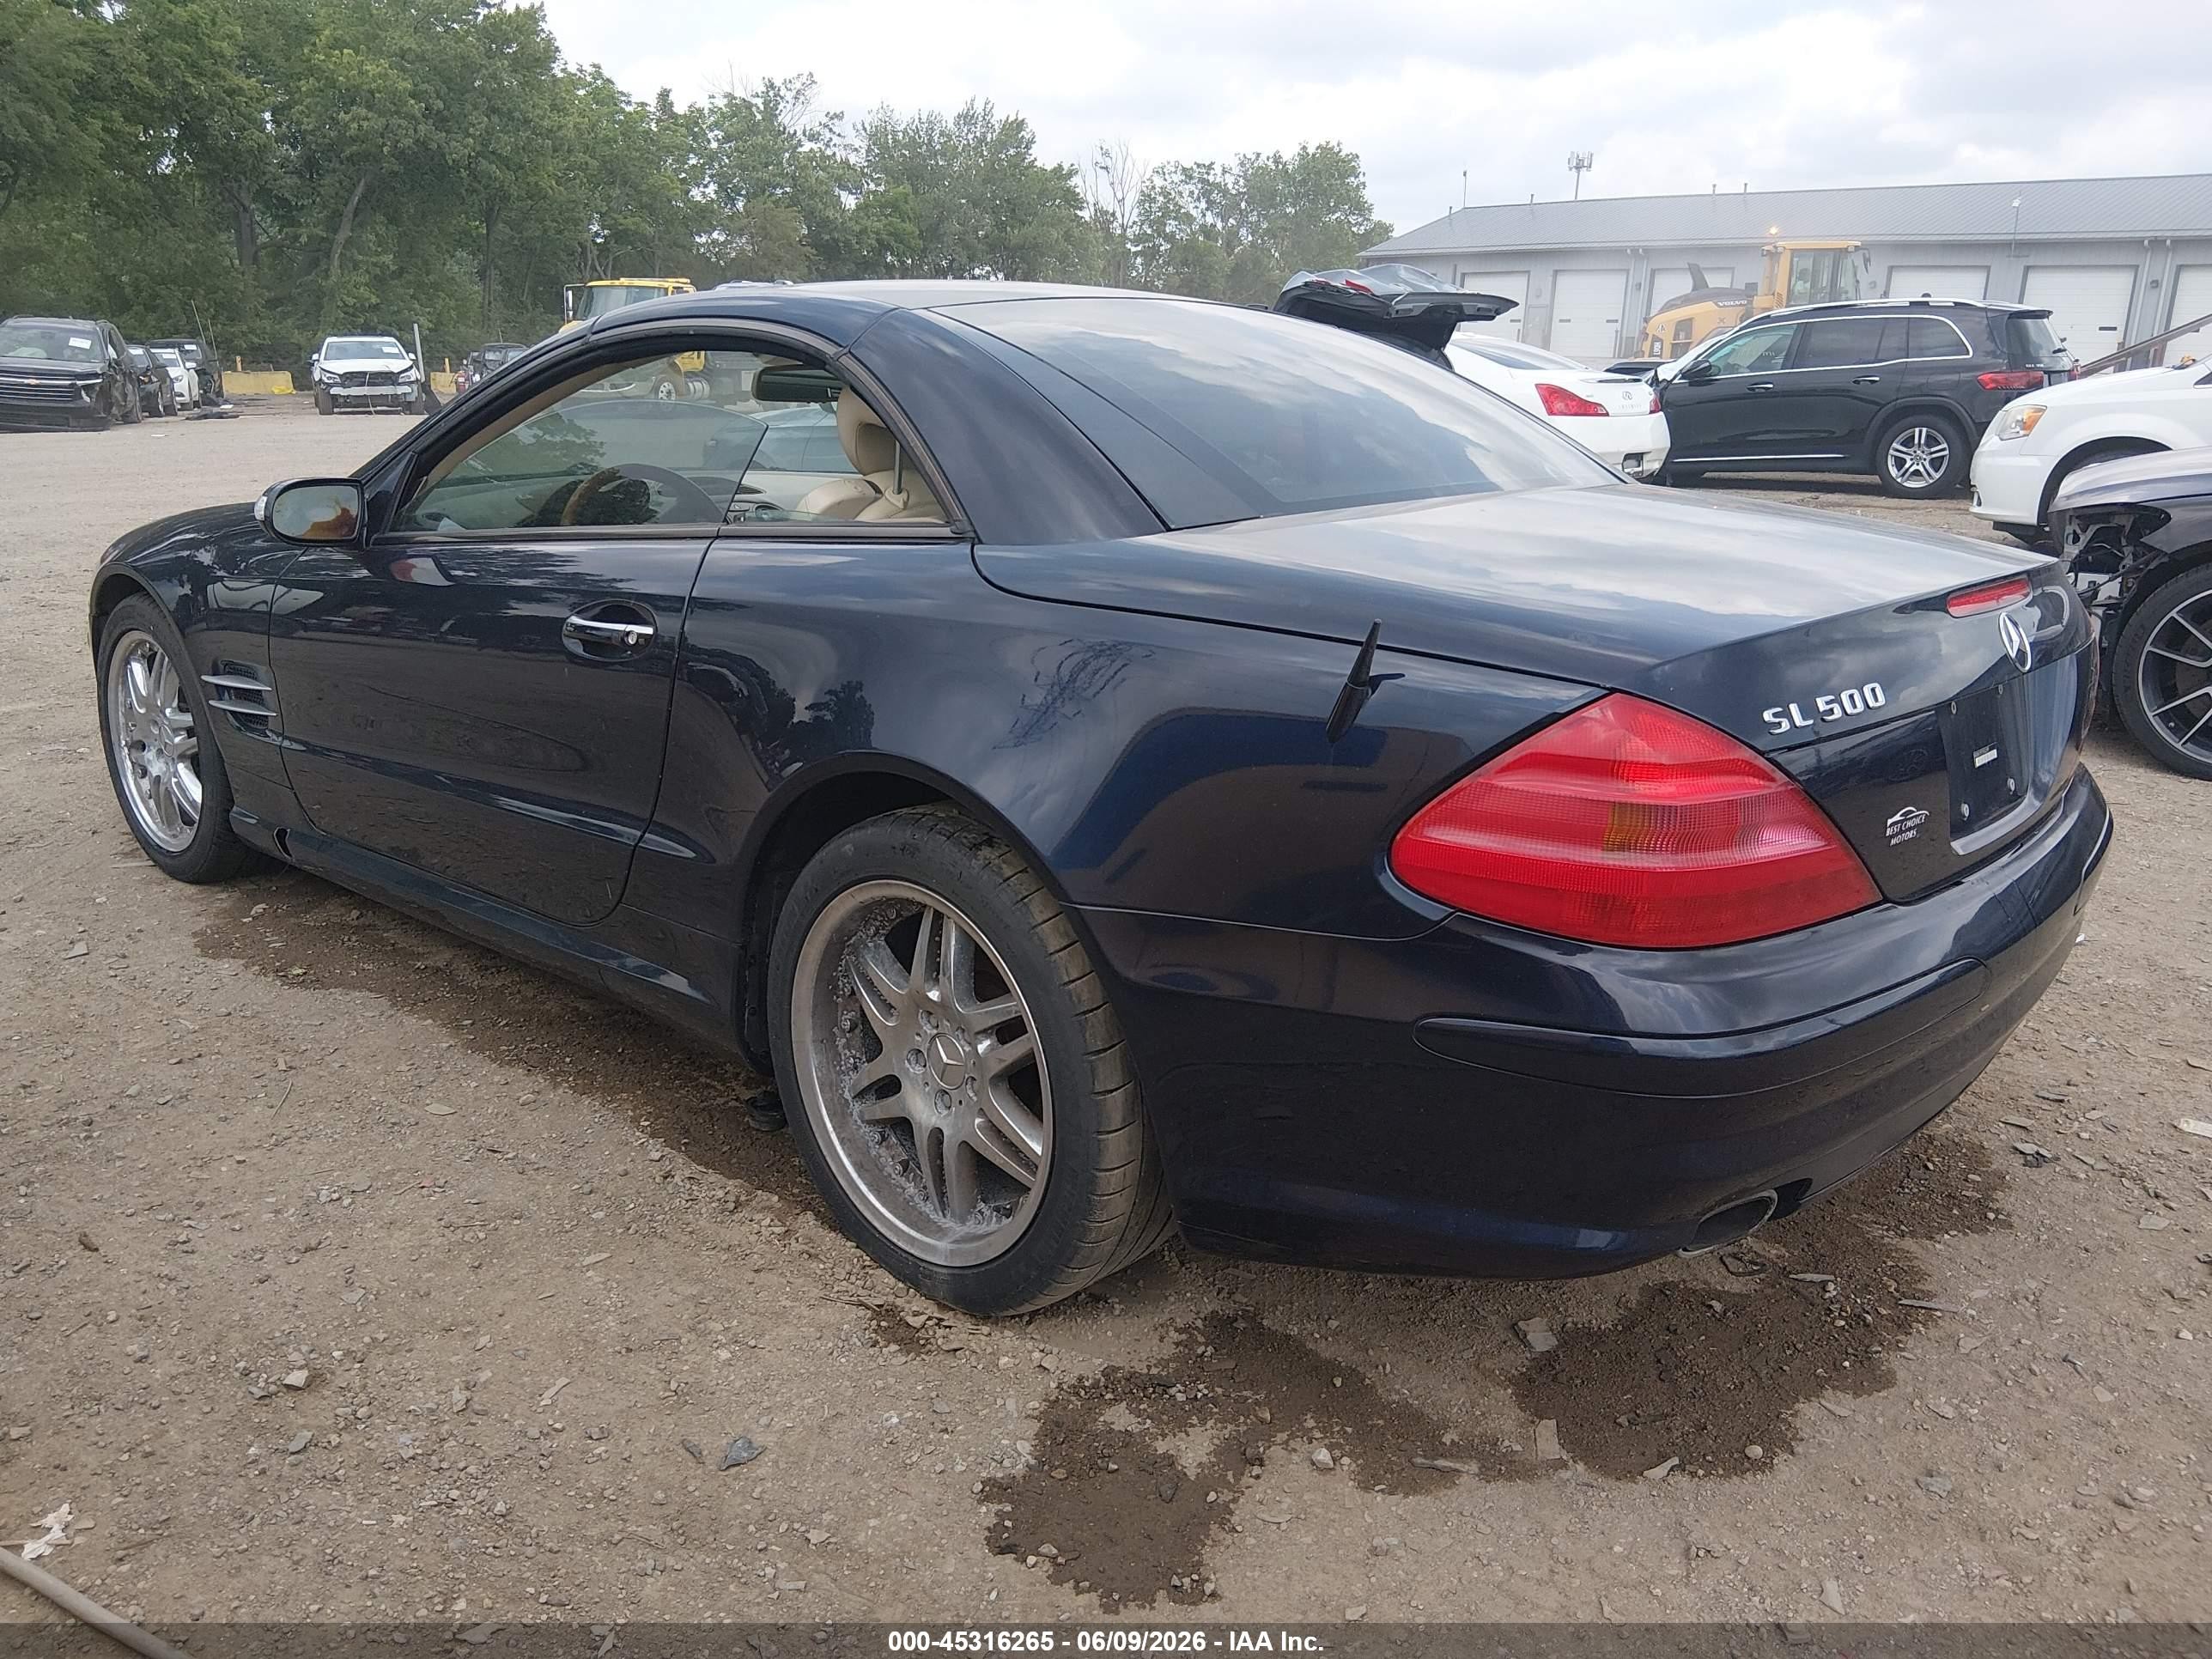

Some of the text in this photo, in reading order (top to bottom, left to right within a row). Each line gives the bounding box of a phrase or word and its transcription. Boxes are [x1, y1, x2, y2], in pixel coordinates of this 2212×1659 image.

[1762, 682, 1887, 735] SL 500
[1886, 814, 1926, 836] BEST CHOICE
[1889, 828, 1917, 847] MOTORS
